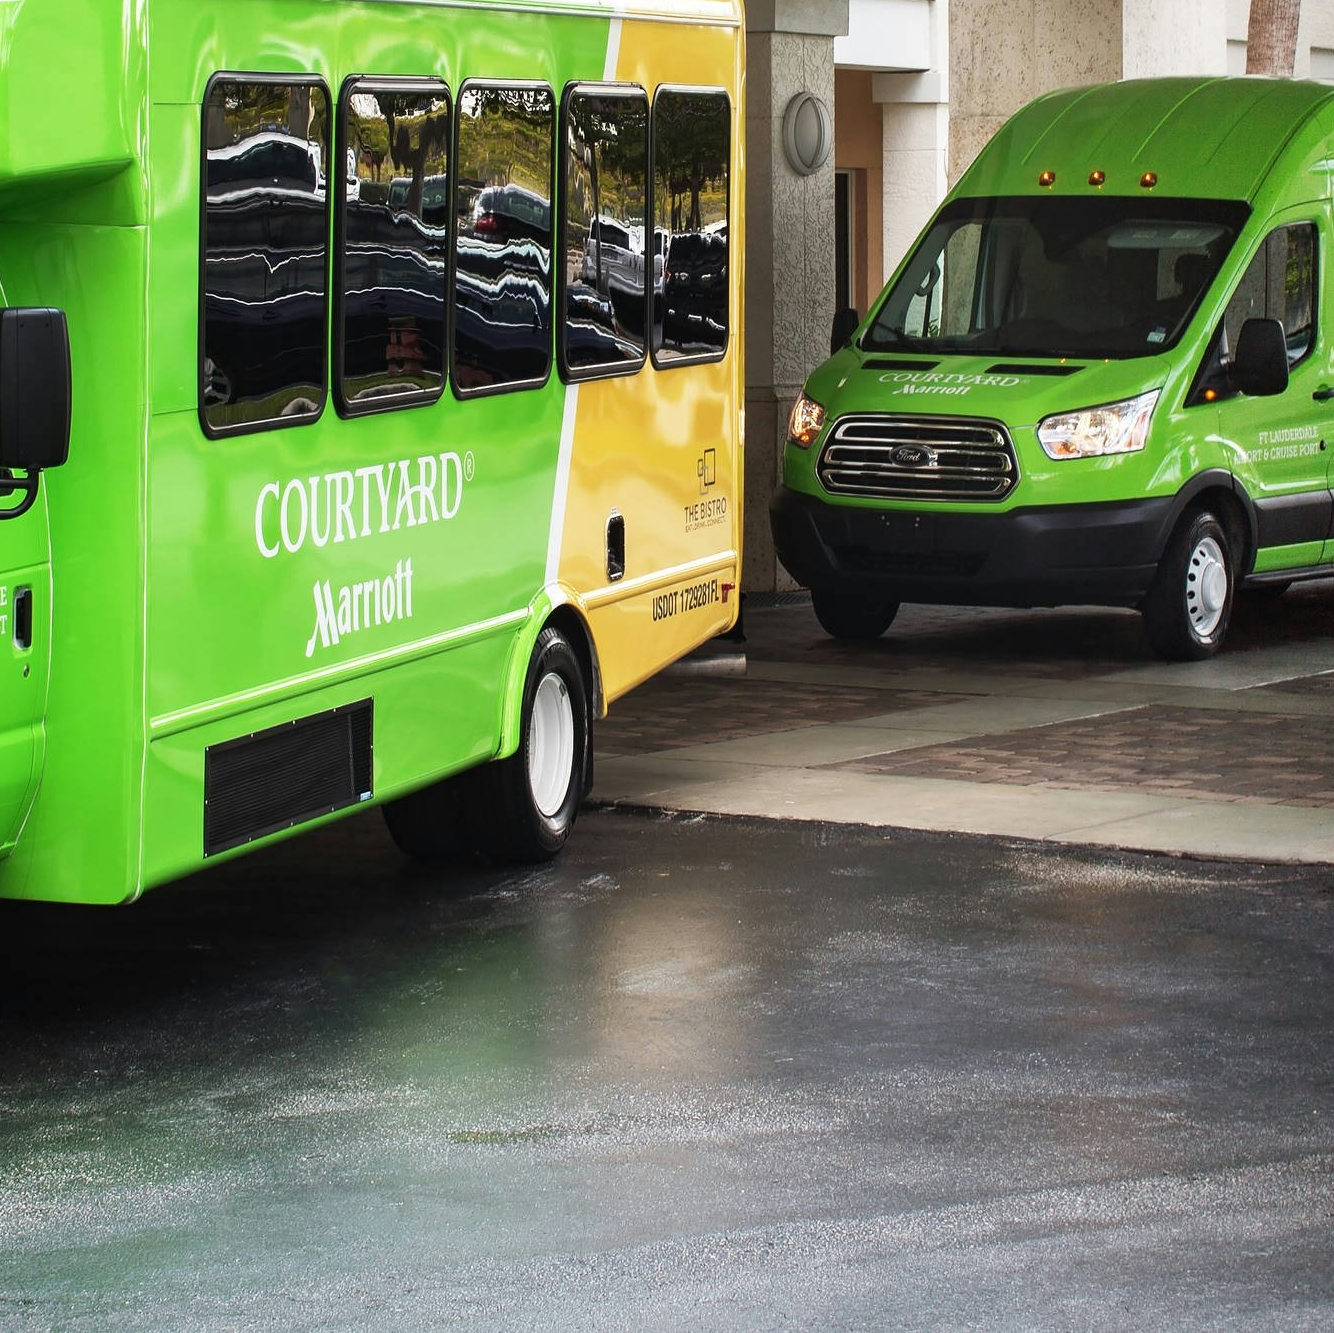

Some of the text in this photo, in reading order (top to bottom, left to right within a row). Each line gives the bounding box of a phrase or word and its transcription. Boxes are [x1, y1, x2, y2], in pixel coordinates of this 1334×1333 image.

[892, 384, 970, 395] Marriott
[1259, 426, 1319, 444] FT LAUDERDALE
[897, 449, 921, 461] Ford
[1234, 449, 1262, 465] AORT
[1270, 445, 1298, 459] CRUISE
[1299, 442, 1319, 456] PORT
[684, 497, 727, 523] THE BISTRO
[305, 557, 413, 658] Marriott
[652, 591, 678, 622] USDOT
